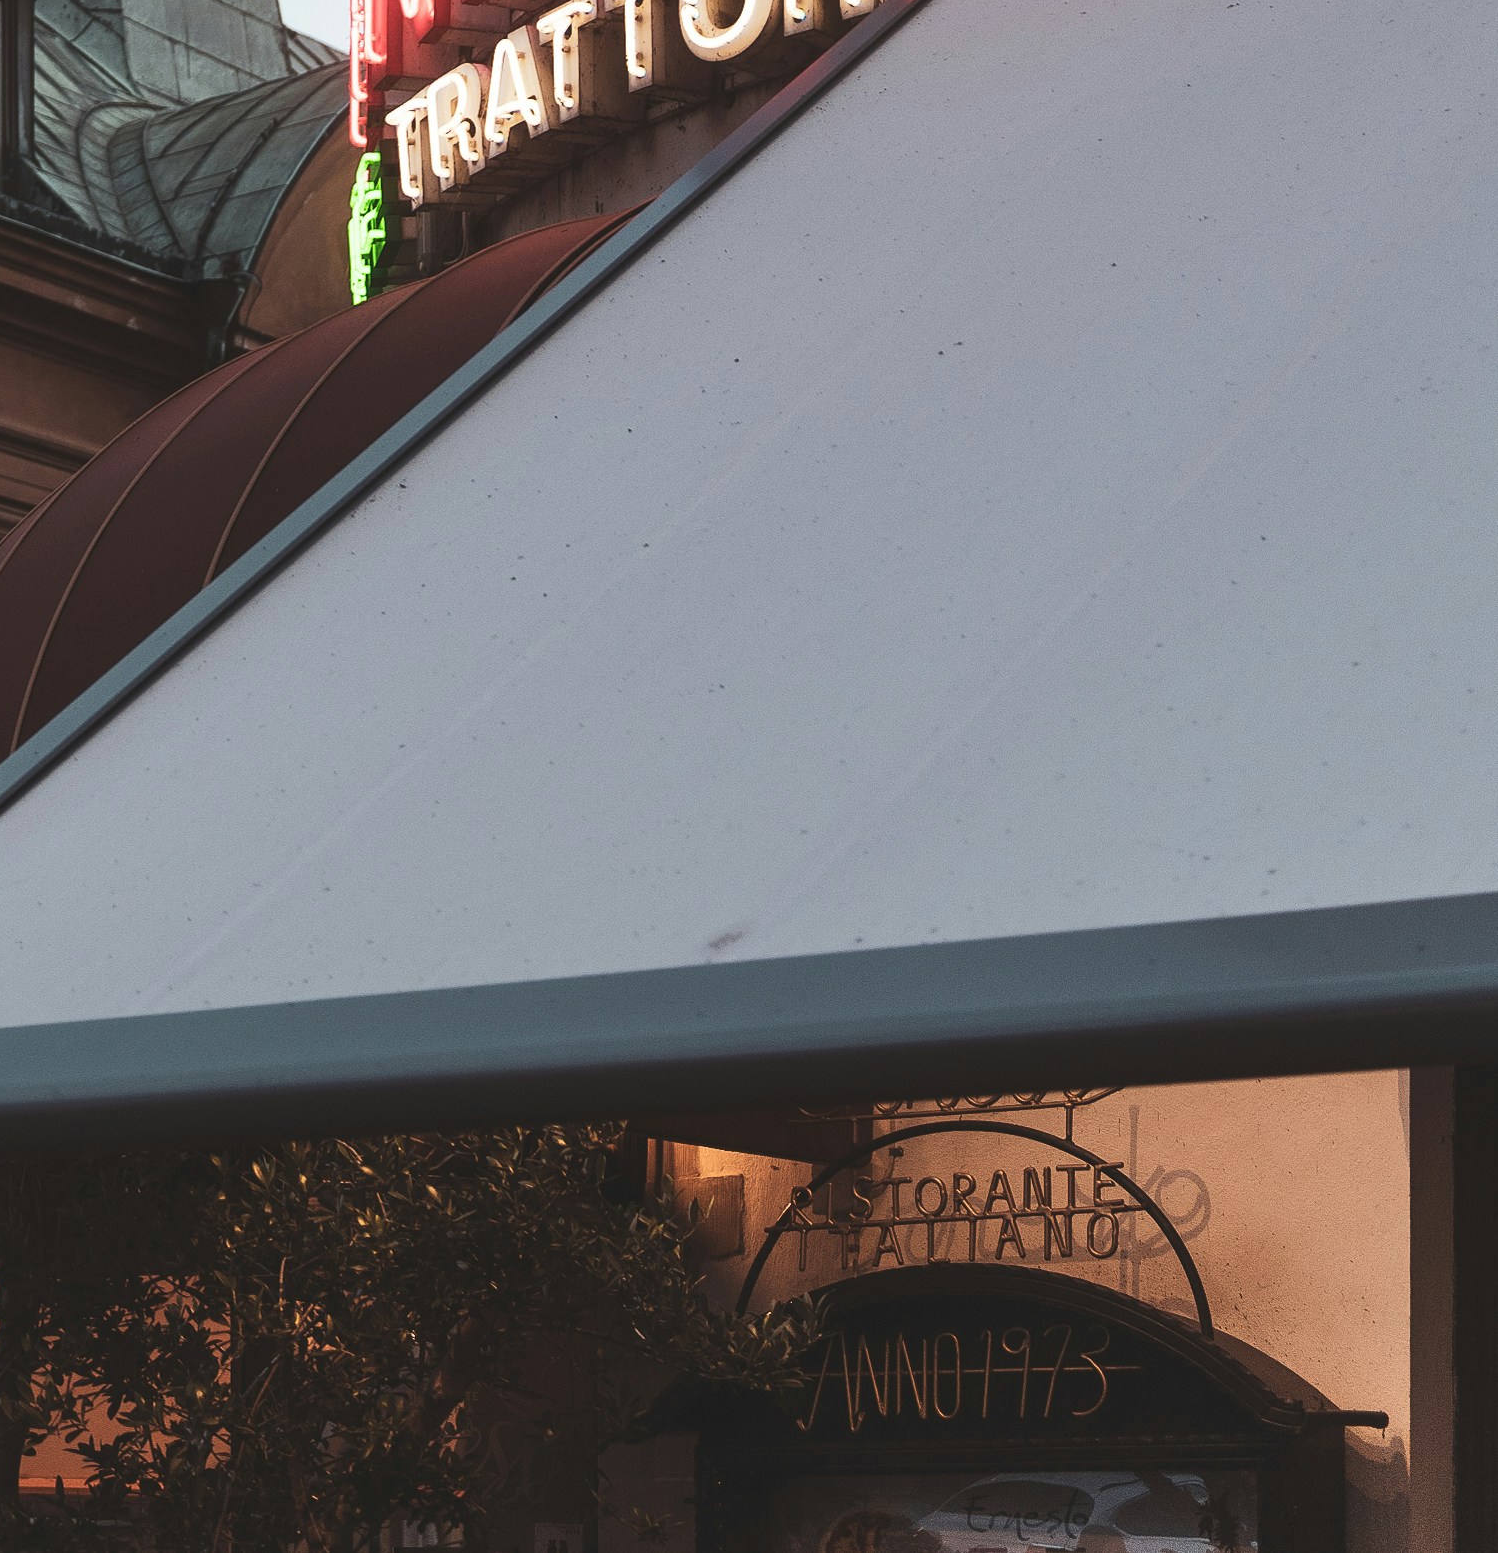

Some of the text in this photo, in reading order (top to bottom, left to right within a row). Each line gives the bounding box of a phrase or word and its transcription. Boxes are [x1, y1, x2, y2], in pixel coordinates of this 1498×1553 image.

[789, 1162, 1124, 1226] RISTORANTE
[797, 1214, 1120, 1271] ITALIANO
[796, 1323, 1111, 1434] ANNO 1973
